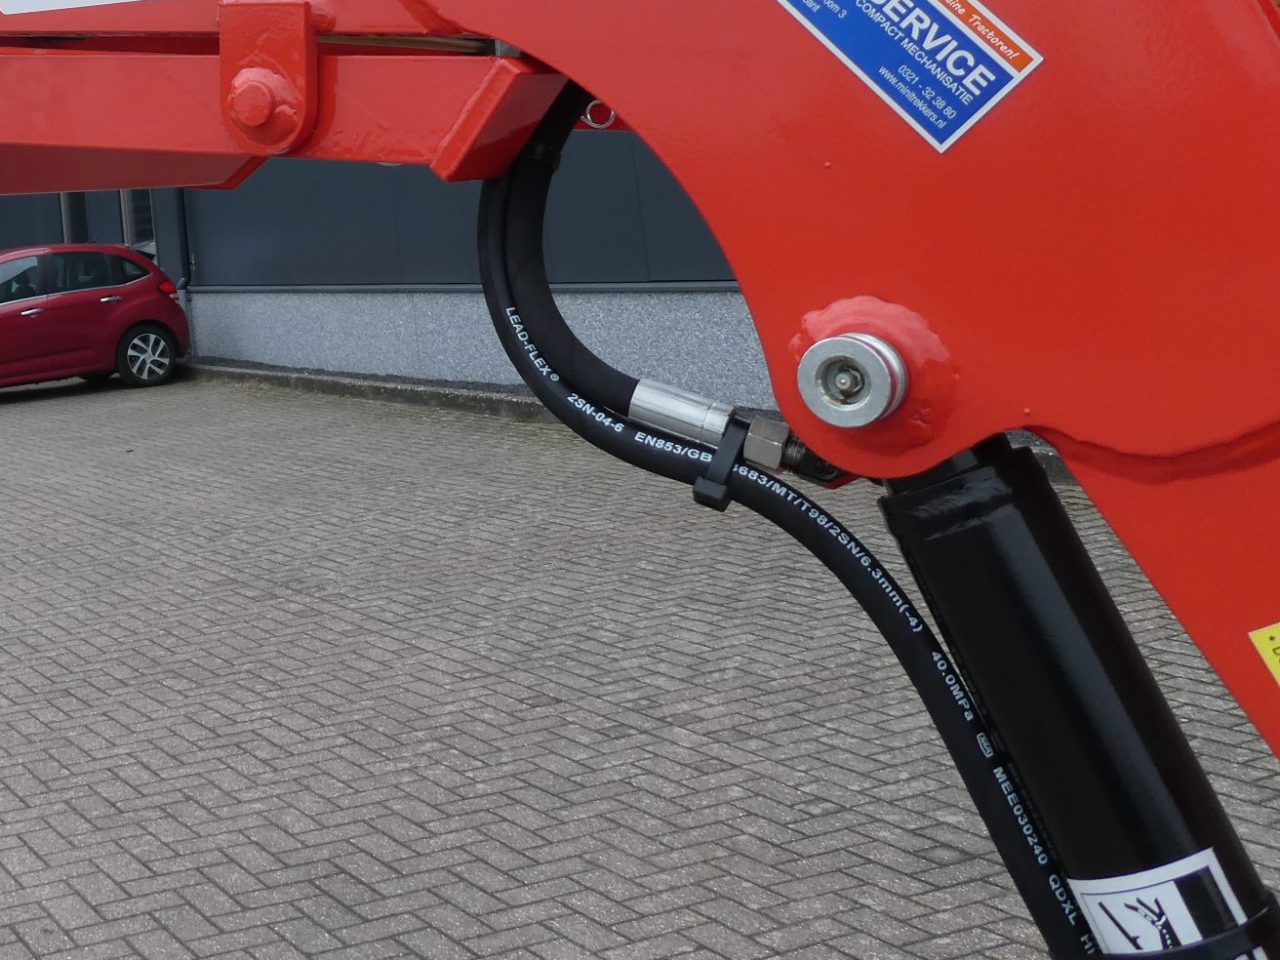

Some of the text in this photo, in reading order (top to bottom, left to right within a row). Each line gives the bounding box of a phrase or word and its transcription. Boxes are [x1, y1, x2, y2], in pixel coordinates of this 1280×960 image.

[838, 9, 847, 19] 3
[968, 13, 1020, 60] Tractoren!
[878, 66, 948, 130] www.minitrekkers.nl
[898, 64, 920, 85] 0321
[922, 86, 934, 99] 32
[932, 95, 946, 110] 38
[943, 106, 957, 120] 80
[901, 38, 974, 106] MECHANISATIE
[567, 392, 625, 433] 2SN-04-6
[931, 650, 974, 722] 40.0MPa
[993, 765, 1048, 865] MEE030240
[1048, 873, 1078, 926] QDXL
